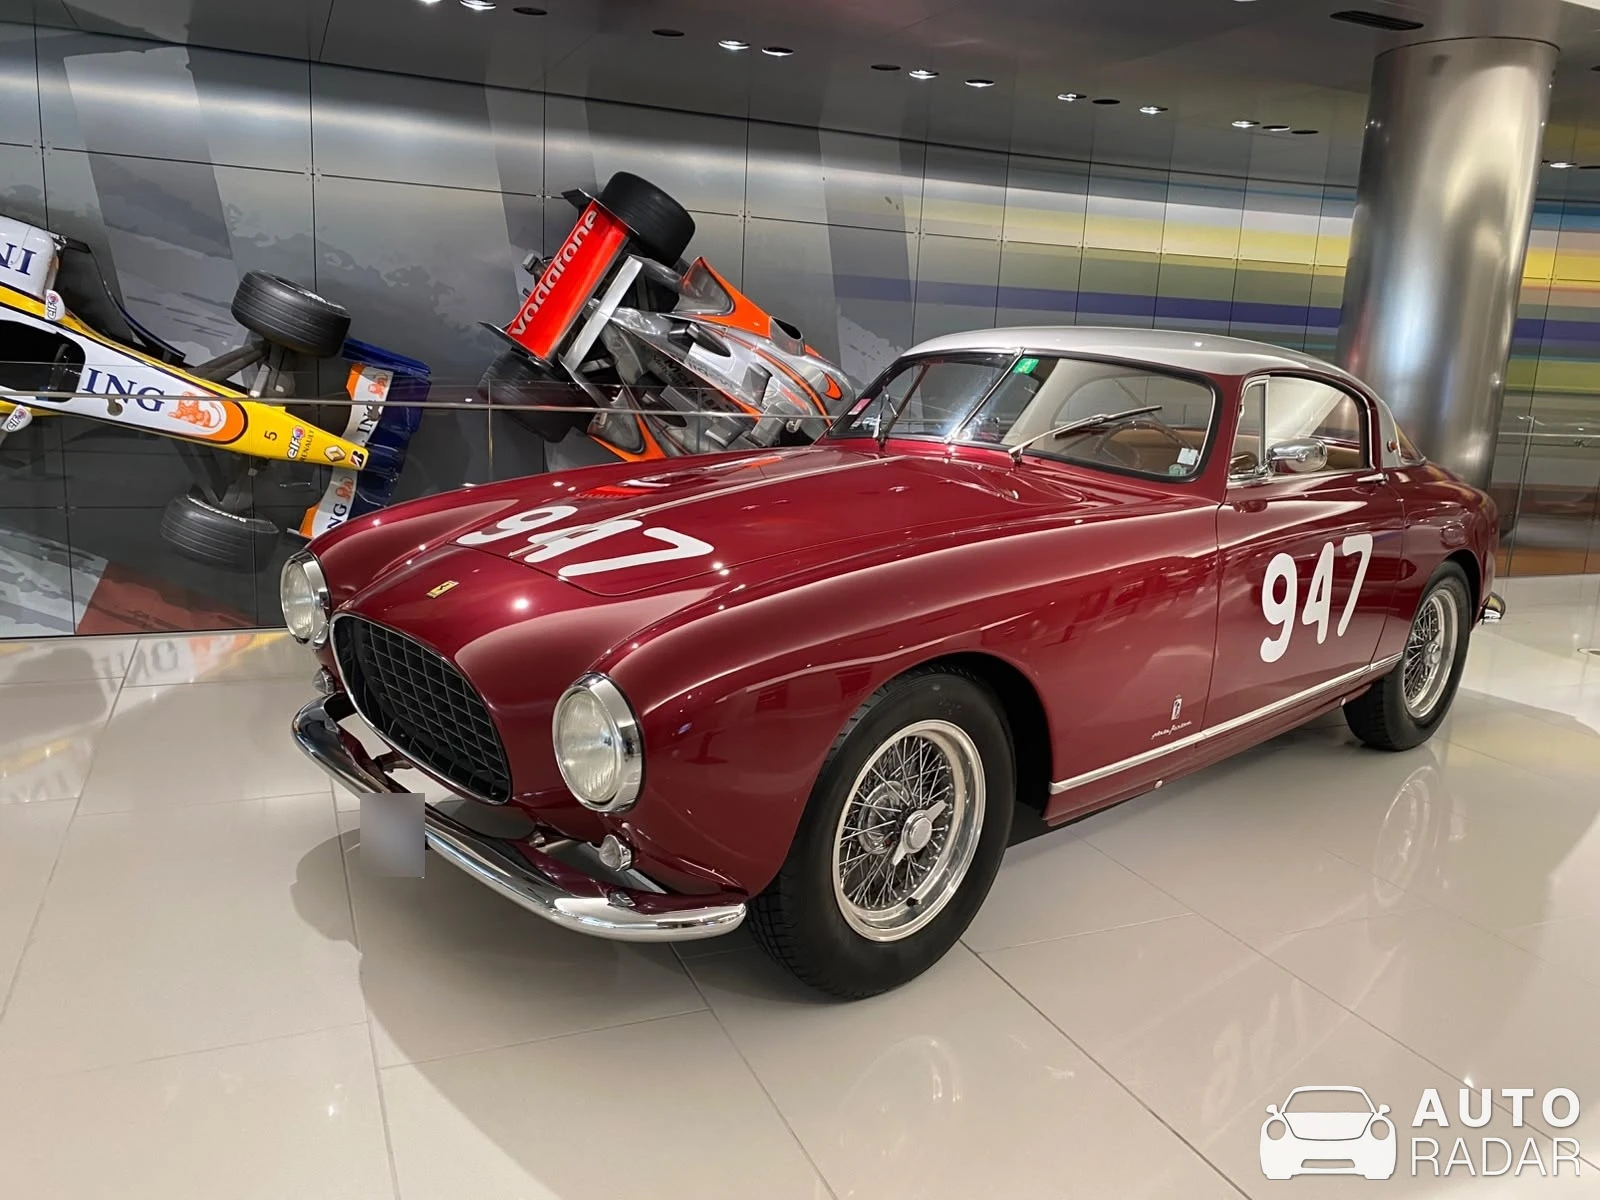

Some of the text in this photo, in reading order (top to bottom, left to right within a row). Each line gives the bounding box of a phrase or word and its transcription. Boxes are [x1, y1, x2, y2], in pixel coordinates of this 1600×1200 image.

[511, 210, 597, 336] vodafone
[82, 368, 165, 412] ING
[264, 430, 278, 441] 5
[456, 505, 714, 577] 947
[1260, 533, 1373, 663] 947
